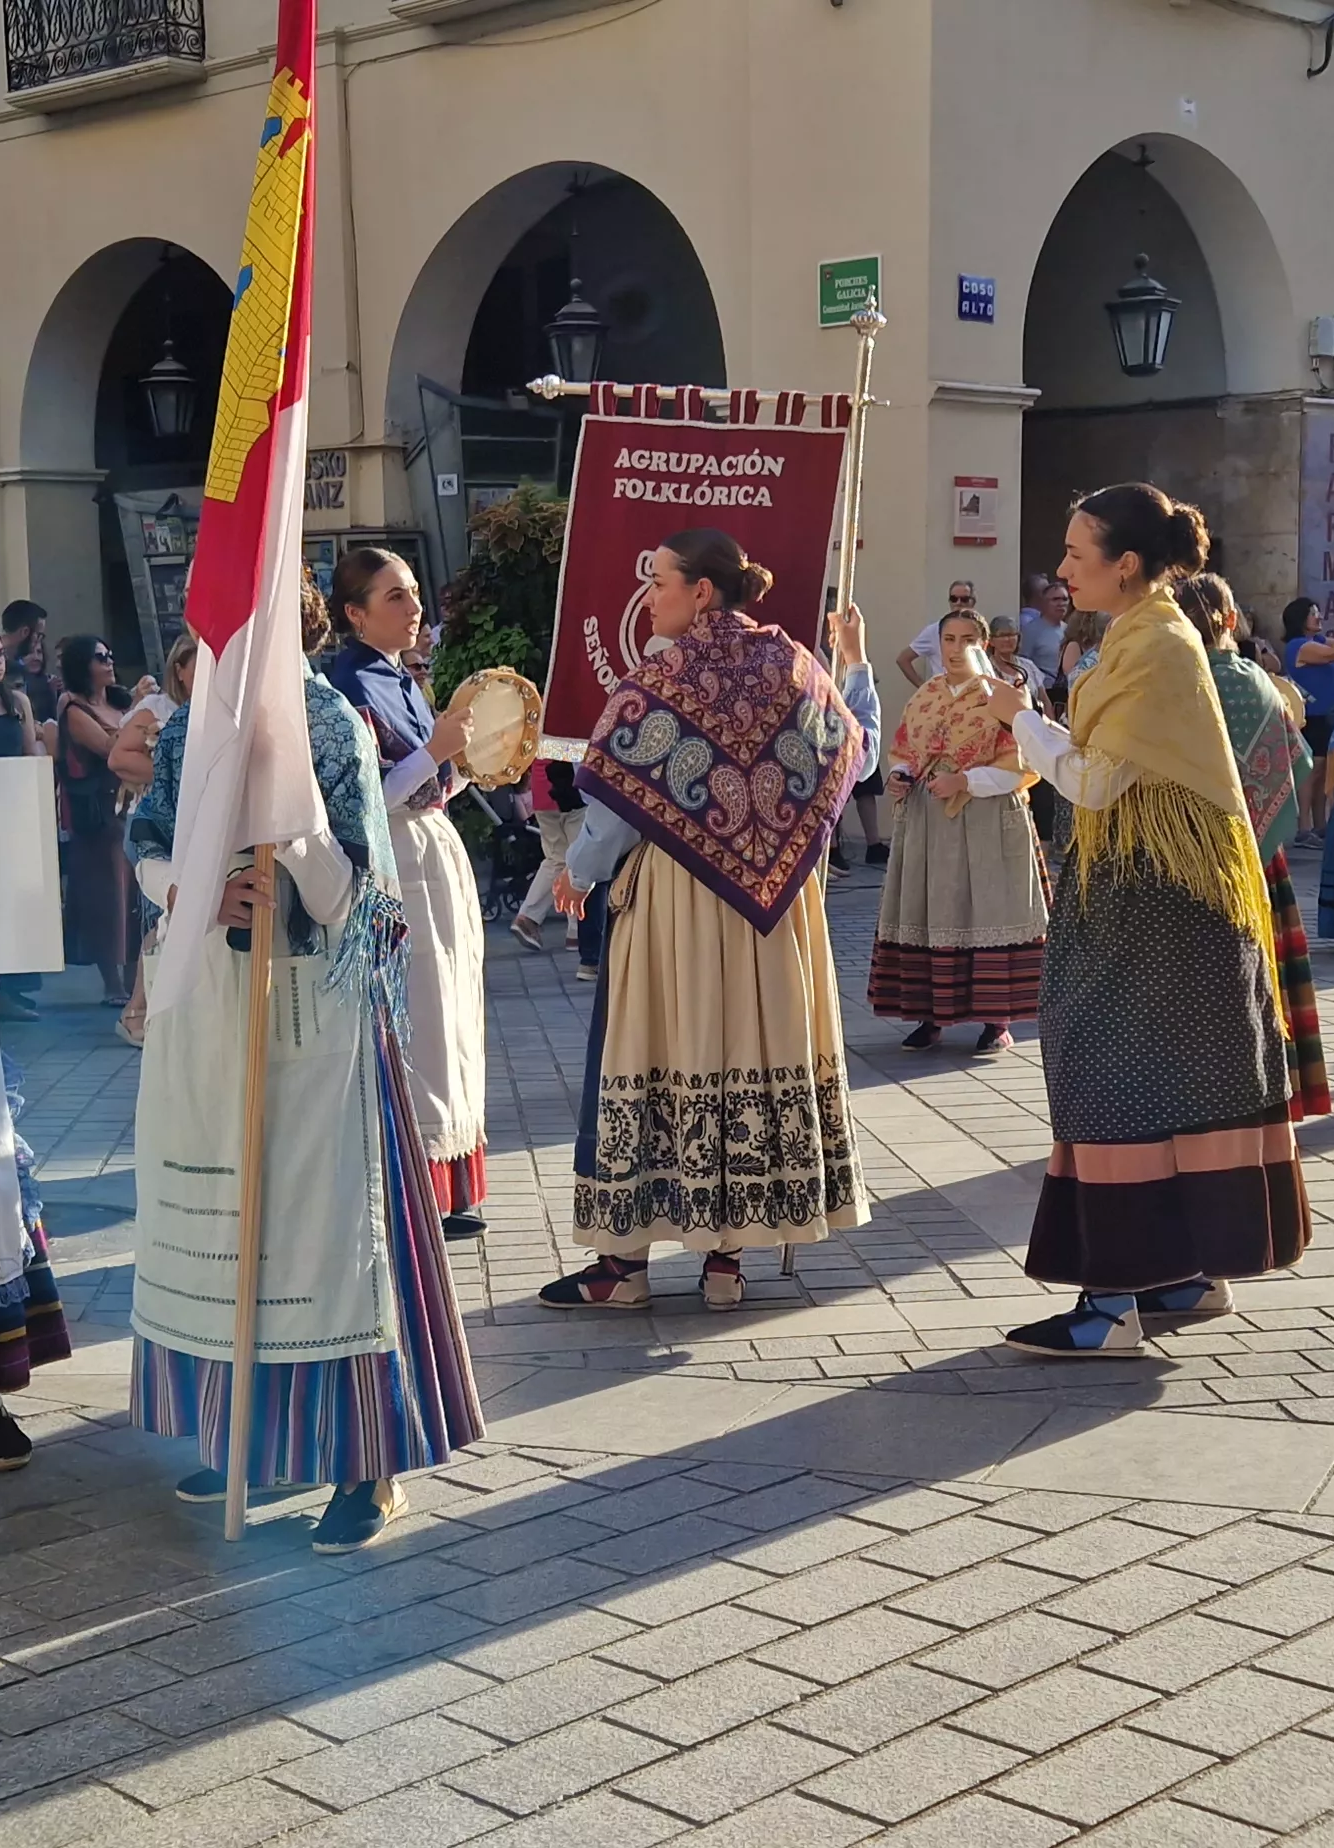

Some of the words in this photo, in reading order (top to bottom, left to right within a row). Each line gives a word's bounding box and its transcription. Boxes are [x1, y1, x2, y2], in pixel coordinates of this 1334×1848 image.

[834, 275, 869, 289] PORCHES
[962, 280, 994, 297] COSO
[836, 287, 867, 300] GALICIA
[961, 300, 993, 316] ALTO
[305, 451, 347, 480] SKO
[613, 447, 785, 478] AGRUPACIÓN
[612, 477, 773, 507] FOLKLÓRICA
